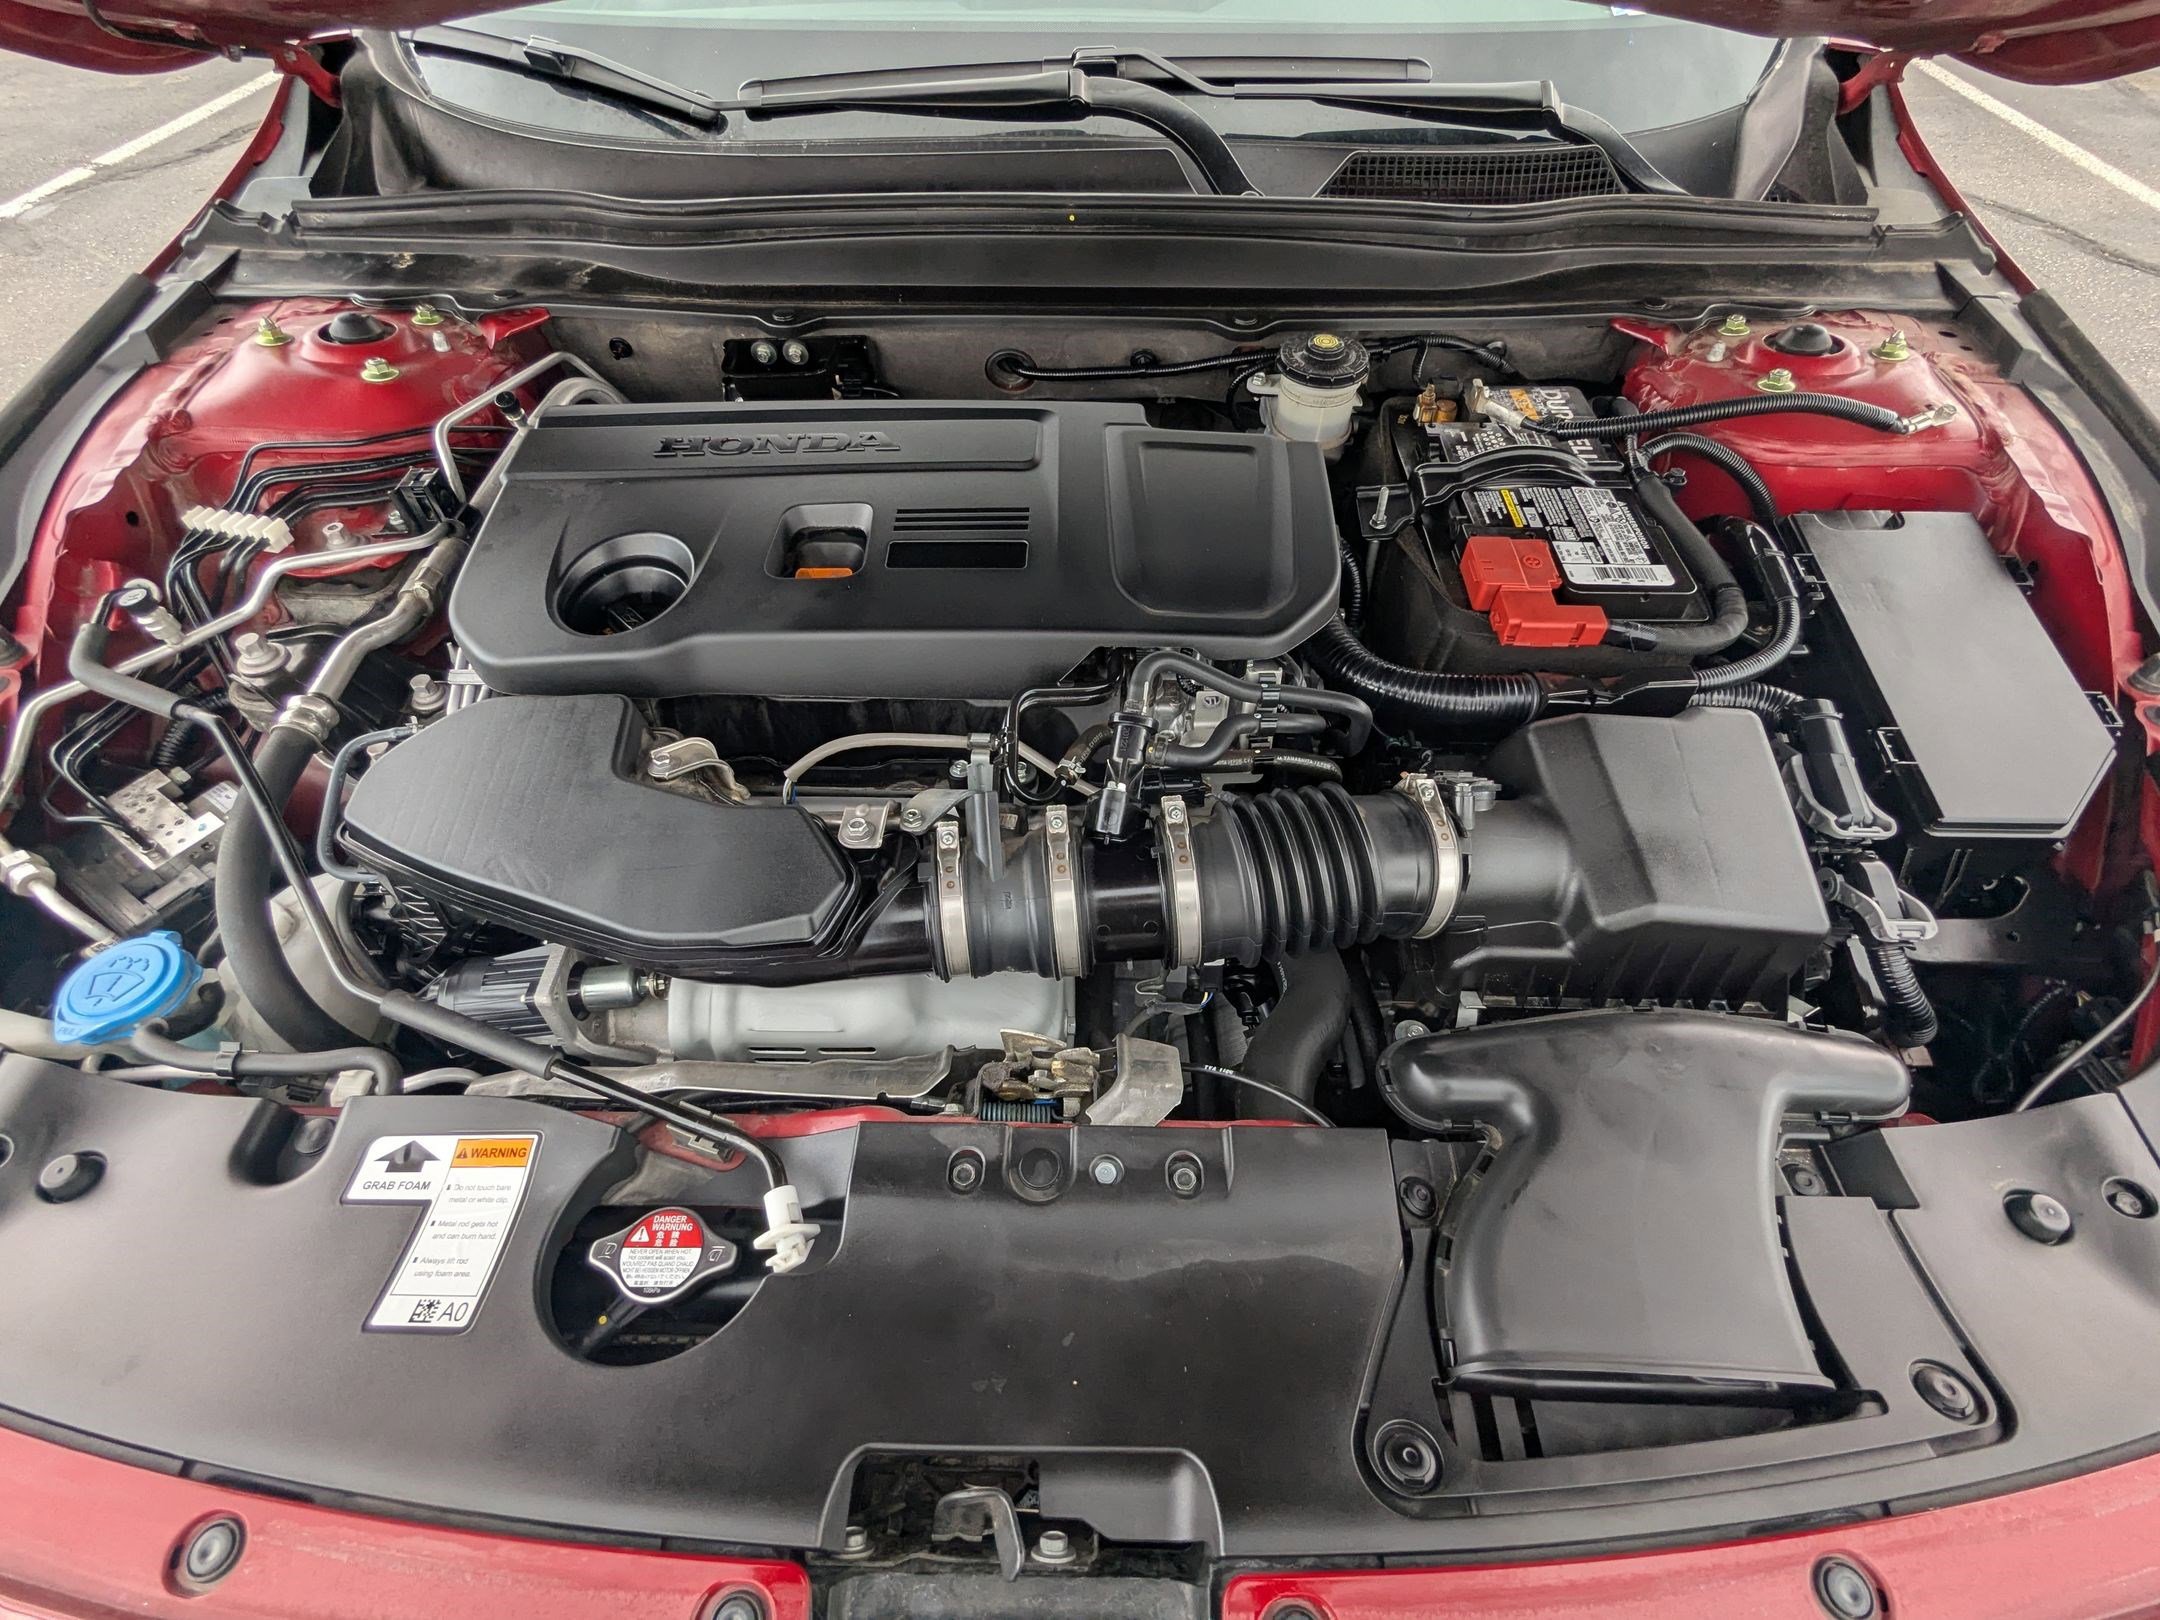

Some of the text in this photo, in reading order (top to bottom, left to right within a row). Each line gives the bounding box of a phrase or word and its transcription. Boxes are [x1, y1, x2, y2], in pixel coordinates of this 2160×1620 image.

[653, 431, 901, 459] HONDA
[471, 1147, 527, 1159] WARNING
[362, 1181, 432, 1190] GRAB FOAM
[654, 1215, 688, 1223] DANGER
[470, 1221, 486, 1229] gets
[652, 1223, 693, 1231] WARNUNG
[420, 1257, 445, 1265] Always
